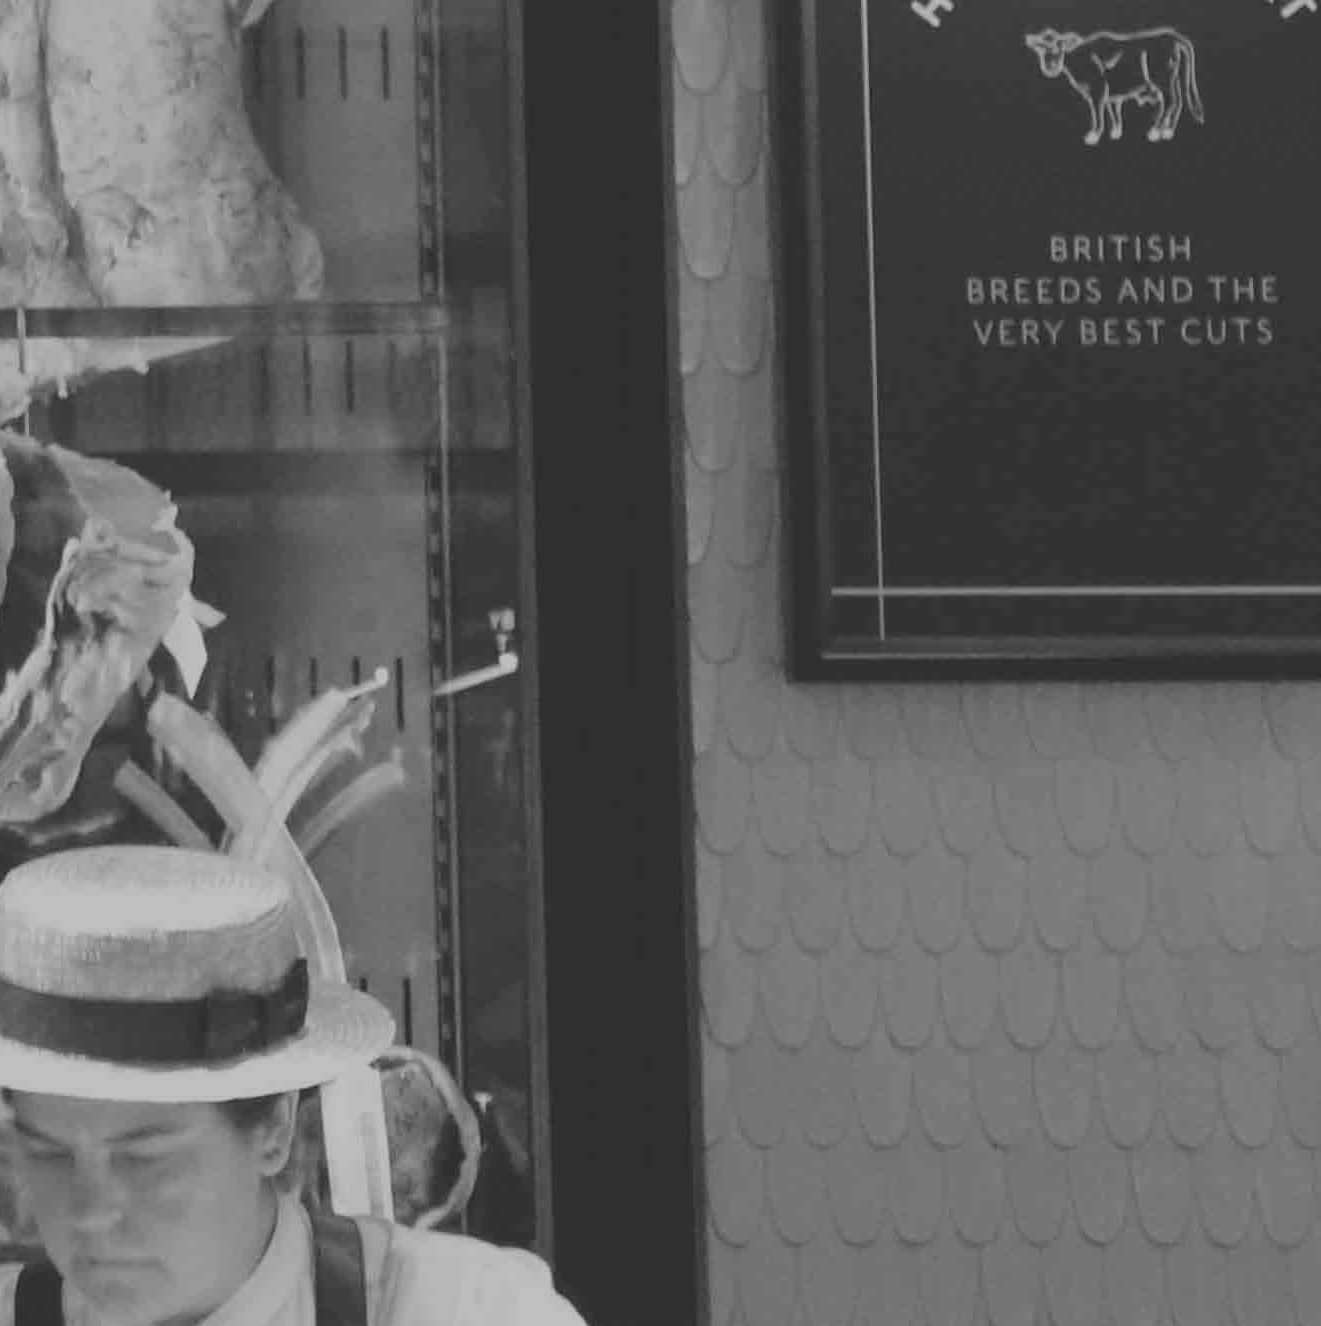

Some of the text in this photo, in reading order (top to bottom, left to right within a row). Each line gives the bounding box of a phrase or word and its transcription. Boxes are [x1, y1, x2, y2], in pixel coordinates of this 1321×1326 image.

[1049, 234, 1191, 263] BRITISH
[966, 275, 1278, 305] BREEDS AND THE
[972, 317, 1273, 346] VERY BEST CUTS
